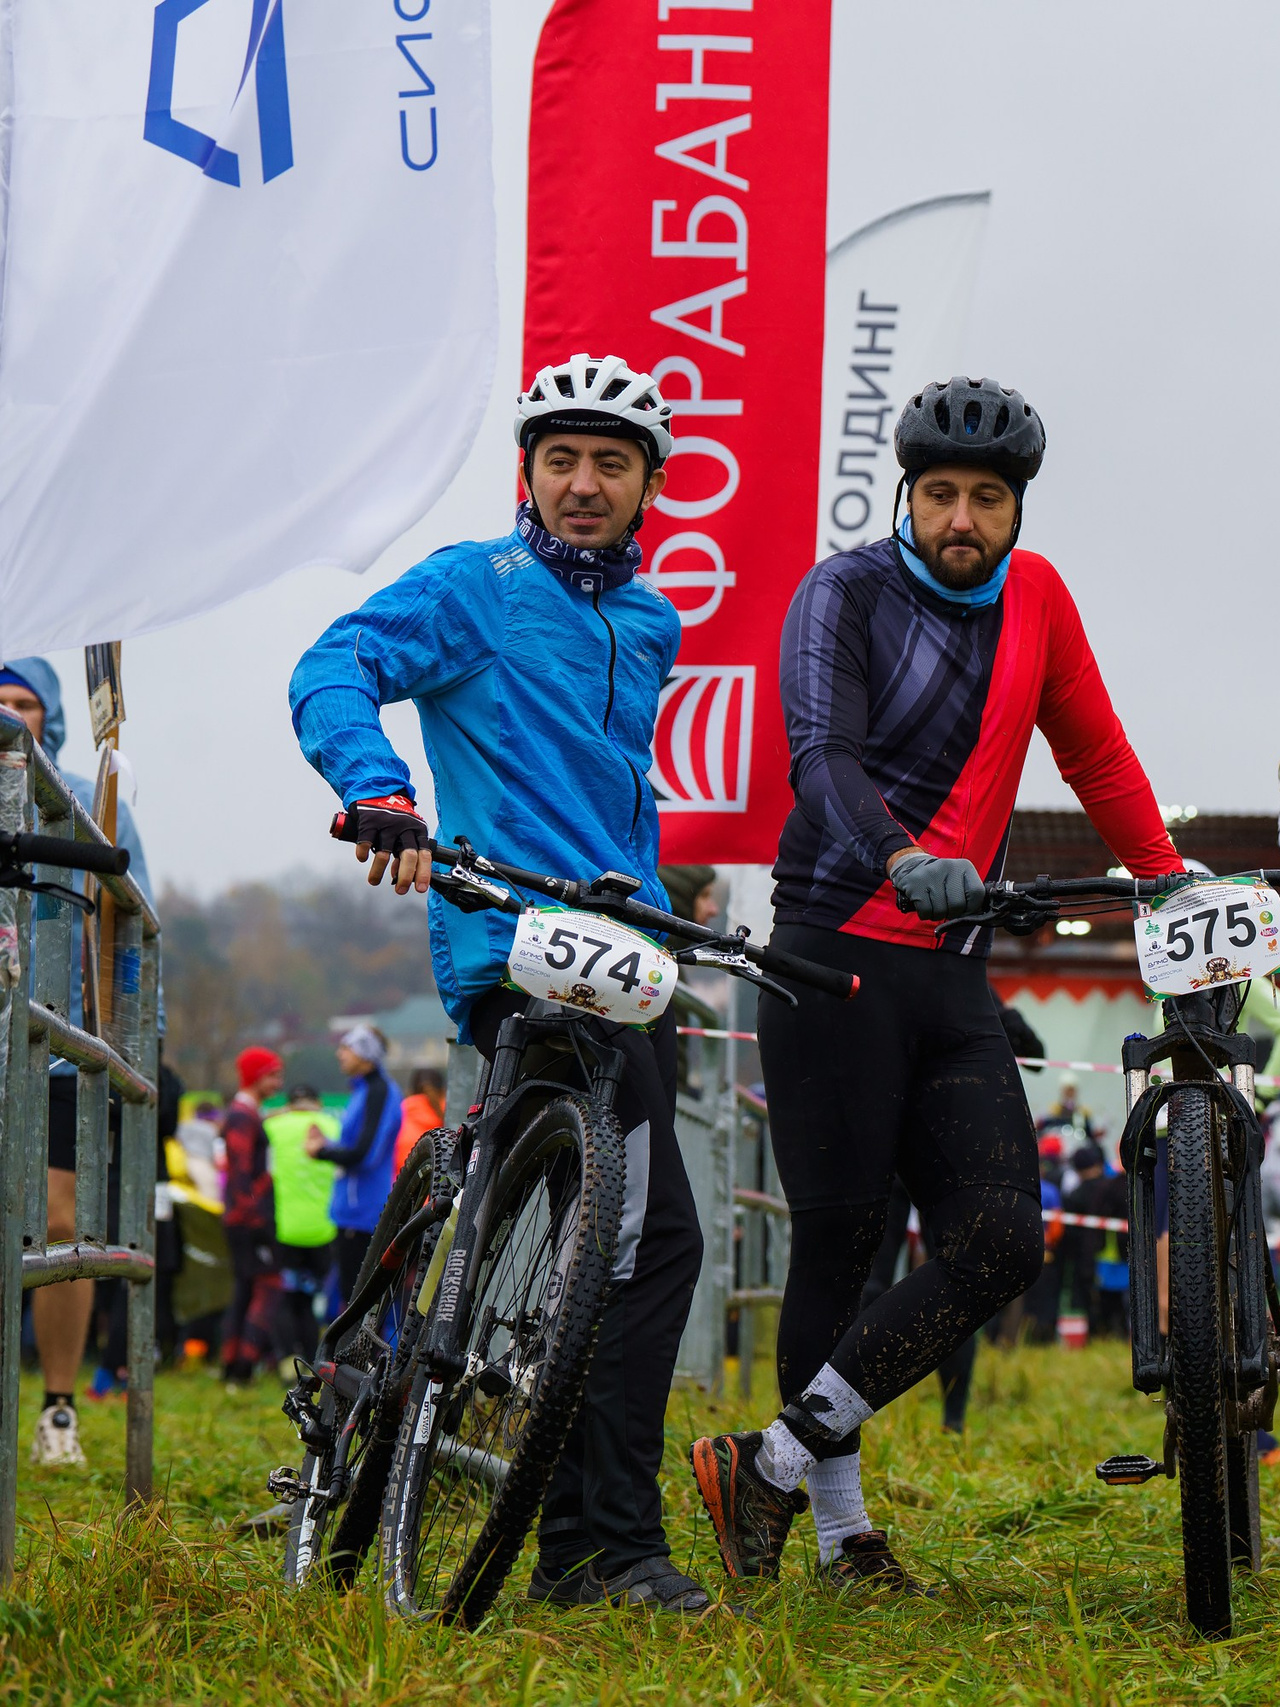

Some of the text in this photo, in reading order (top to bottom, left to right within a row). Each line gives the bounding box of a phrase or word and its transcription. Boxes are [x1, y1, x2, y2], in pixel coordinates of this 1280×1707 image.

[644, 0, 754, 627] ФОРАБАН
[827, 290, 899, 556] ОЛДИНГ
[615, 872, 638, 885] GARMIN
[545, 928, 641, 994] 574
[1166, 902, 1257, 962] 575
[436, 1249, 467, 1322] ROCKSHOX
[421, 1401, 430, 1440] DT SWISS
[385, 1401, 415, 1515] ROCKET
